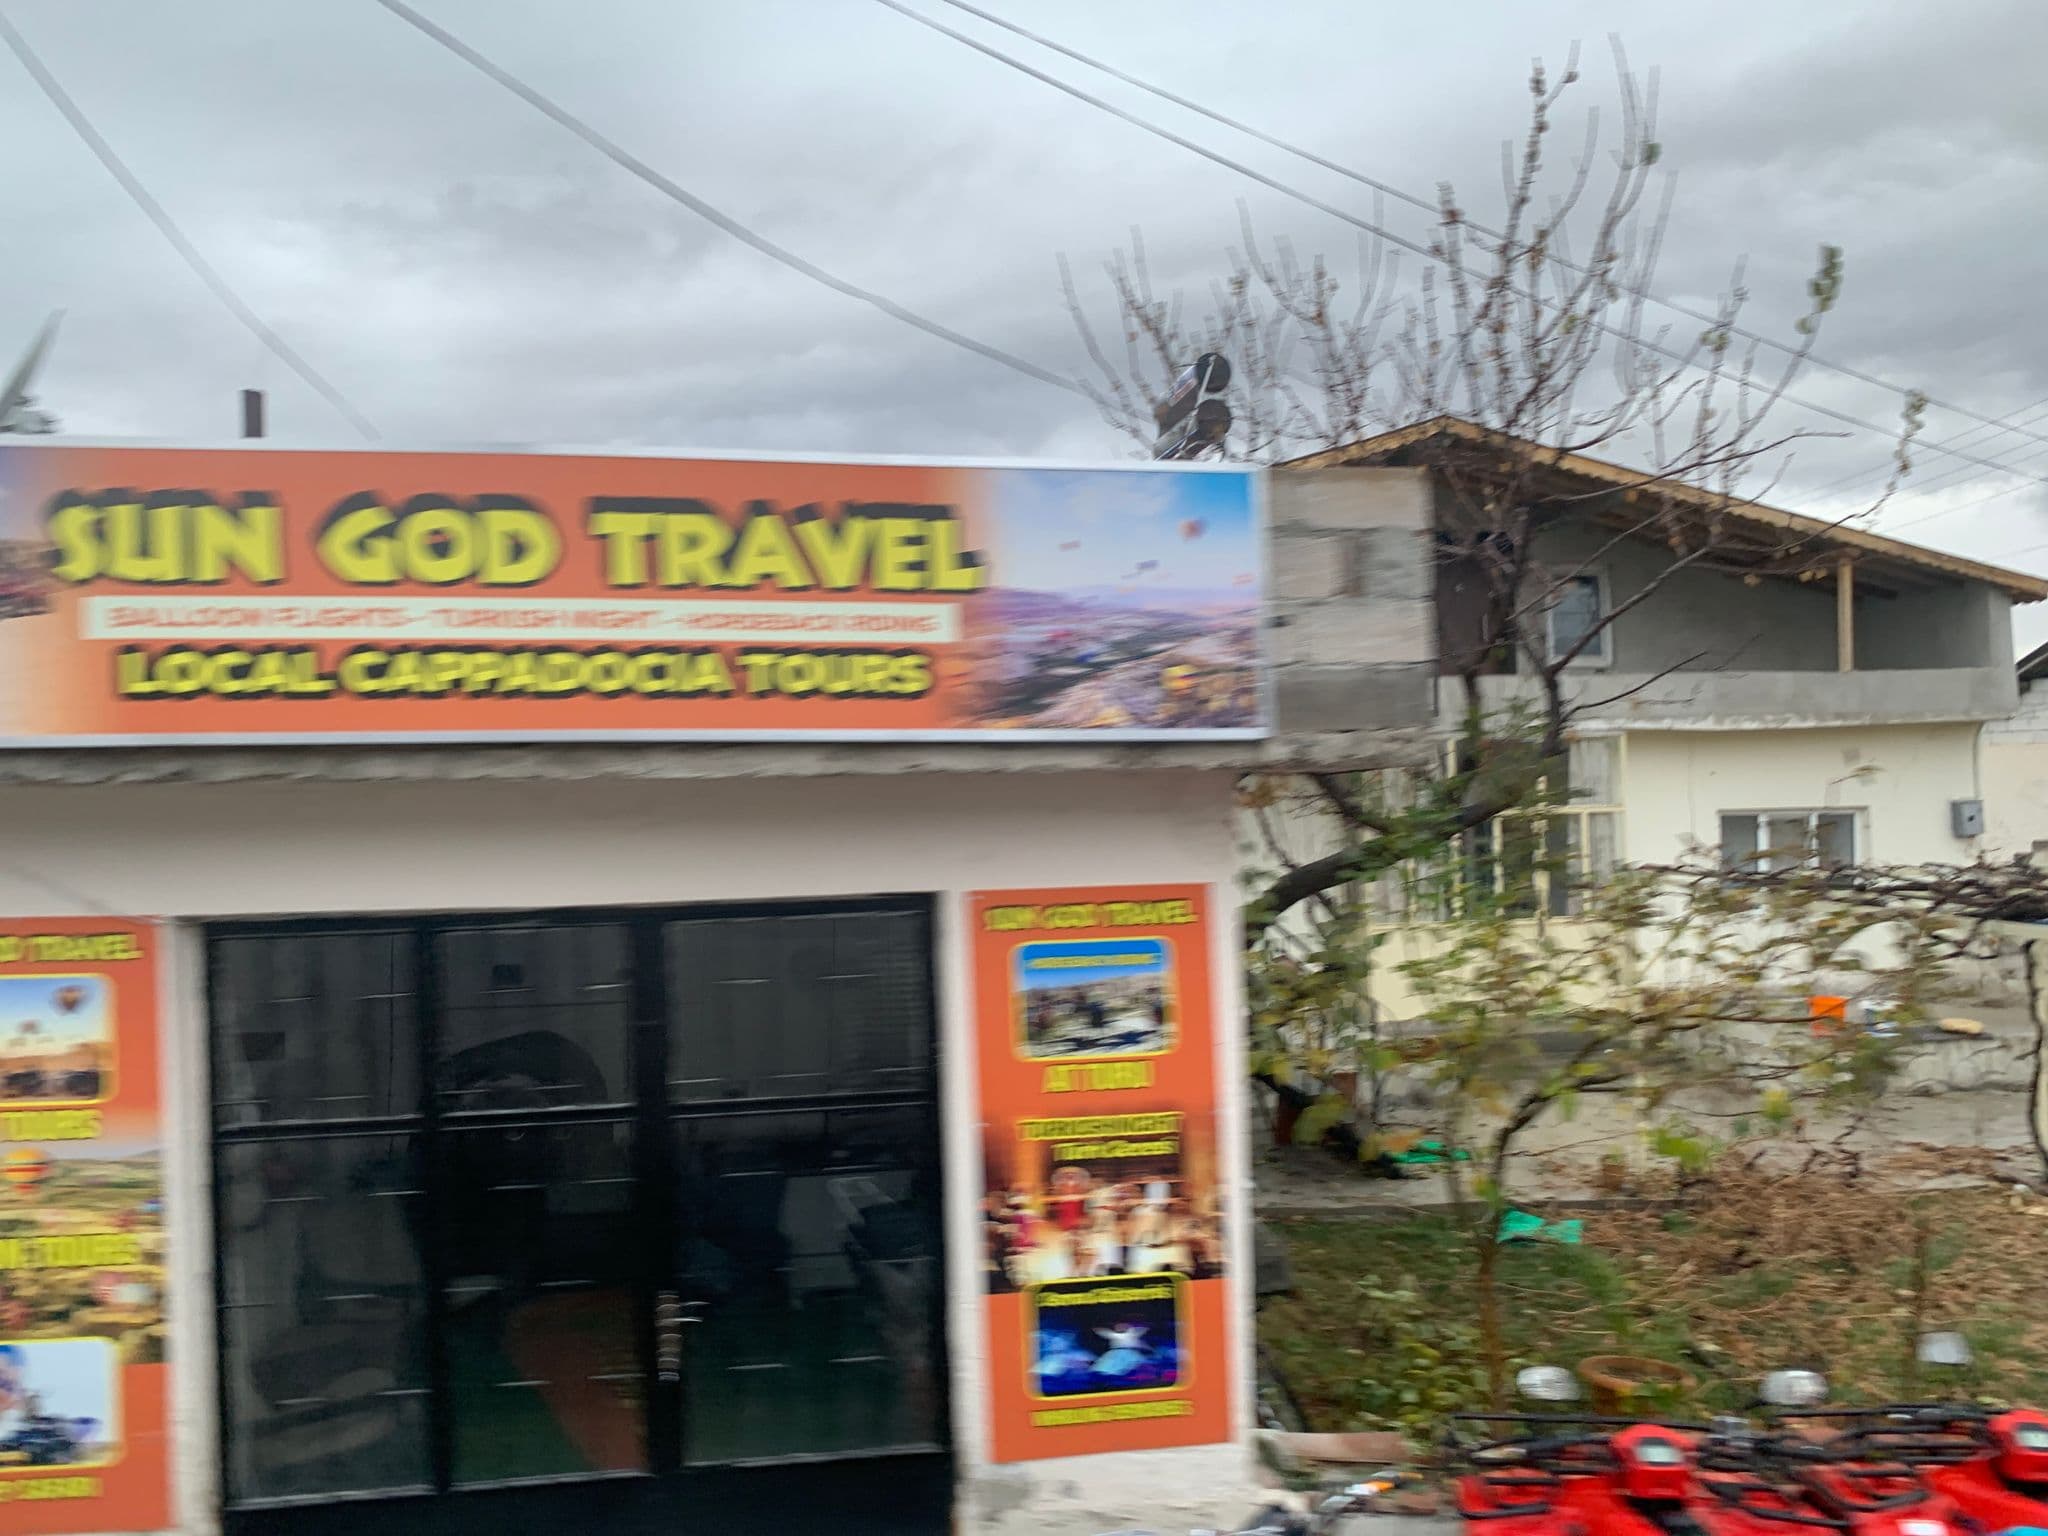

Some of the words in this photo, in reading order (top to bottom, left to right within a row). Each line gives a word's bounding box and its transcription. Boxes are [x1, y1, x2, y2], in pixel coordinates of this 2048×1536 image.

[46, 490, 285, 585] SUN
[315, 492, 564, 587] GOD
[586, 497, 986, 592] TRAVEL
[108, 606, 270, 629] BALLOON
[274, 606, 406, 630] FLIGHTS
[432, 607, 562, 631] TURKISH
[567, 608, 658, 632] NIGHT
[684, 611, 844, 633] HORSEBACK
[849, 613, 938, 634] RIDING
[115, 643, 336, 700] LOCAL
[337, 644, 733, 700] CAPPADOCIA
[737, 646, 933, 699] TOURS
